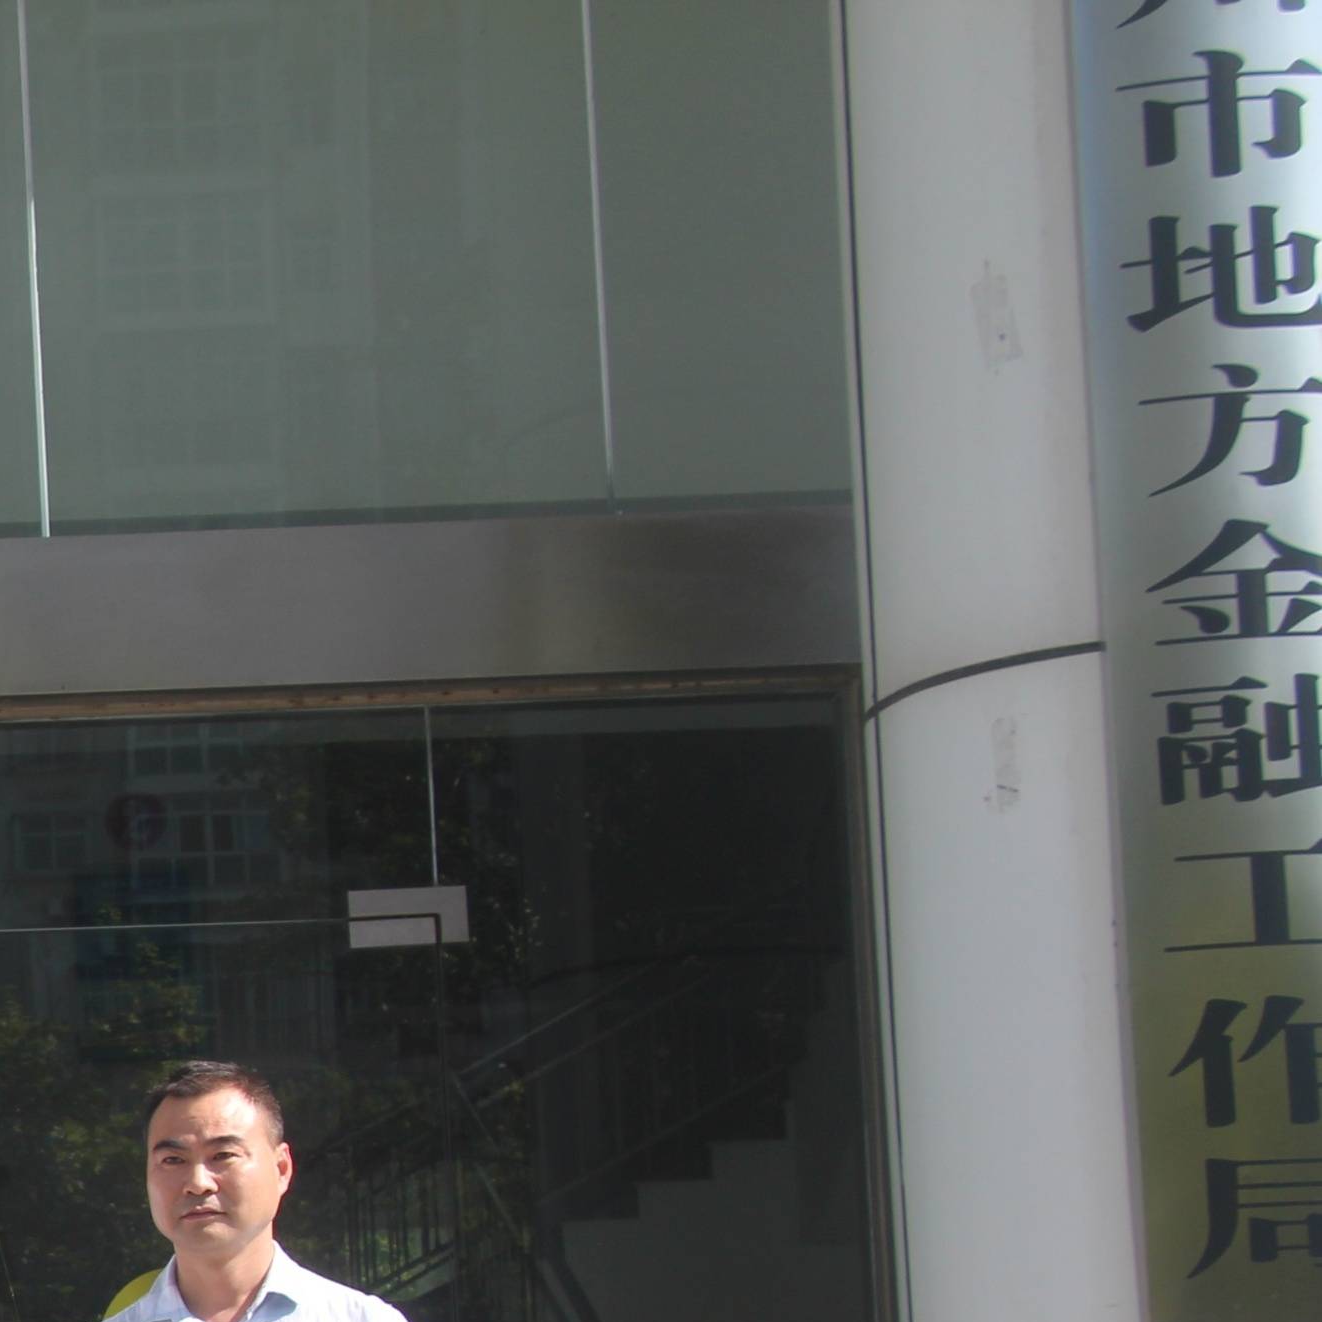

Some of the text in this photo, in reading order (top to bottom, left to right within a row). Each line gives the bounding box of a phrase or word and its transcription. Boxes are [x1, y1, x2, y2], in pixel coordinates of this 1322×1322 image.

[1115, 0, 1322, 1278] 市地方金融工作局
